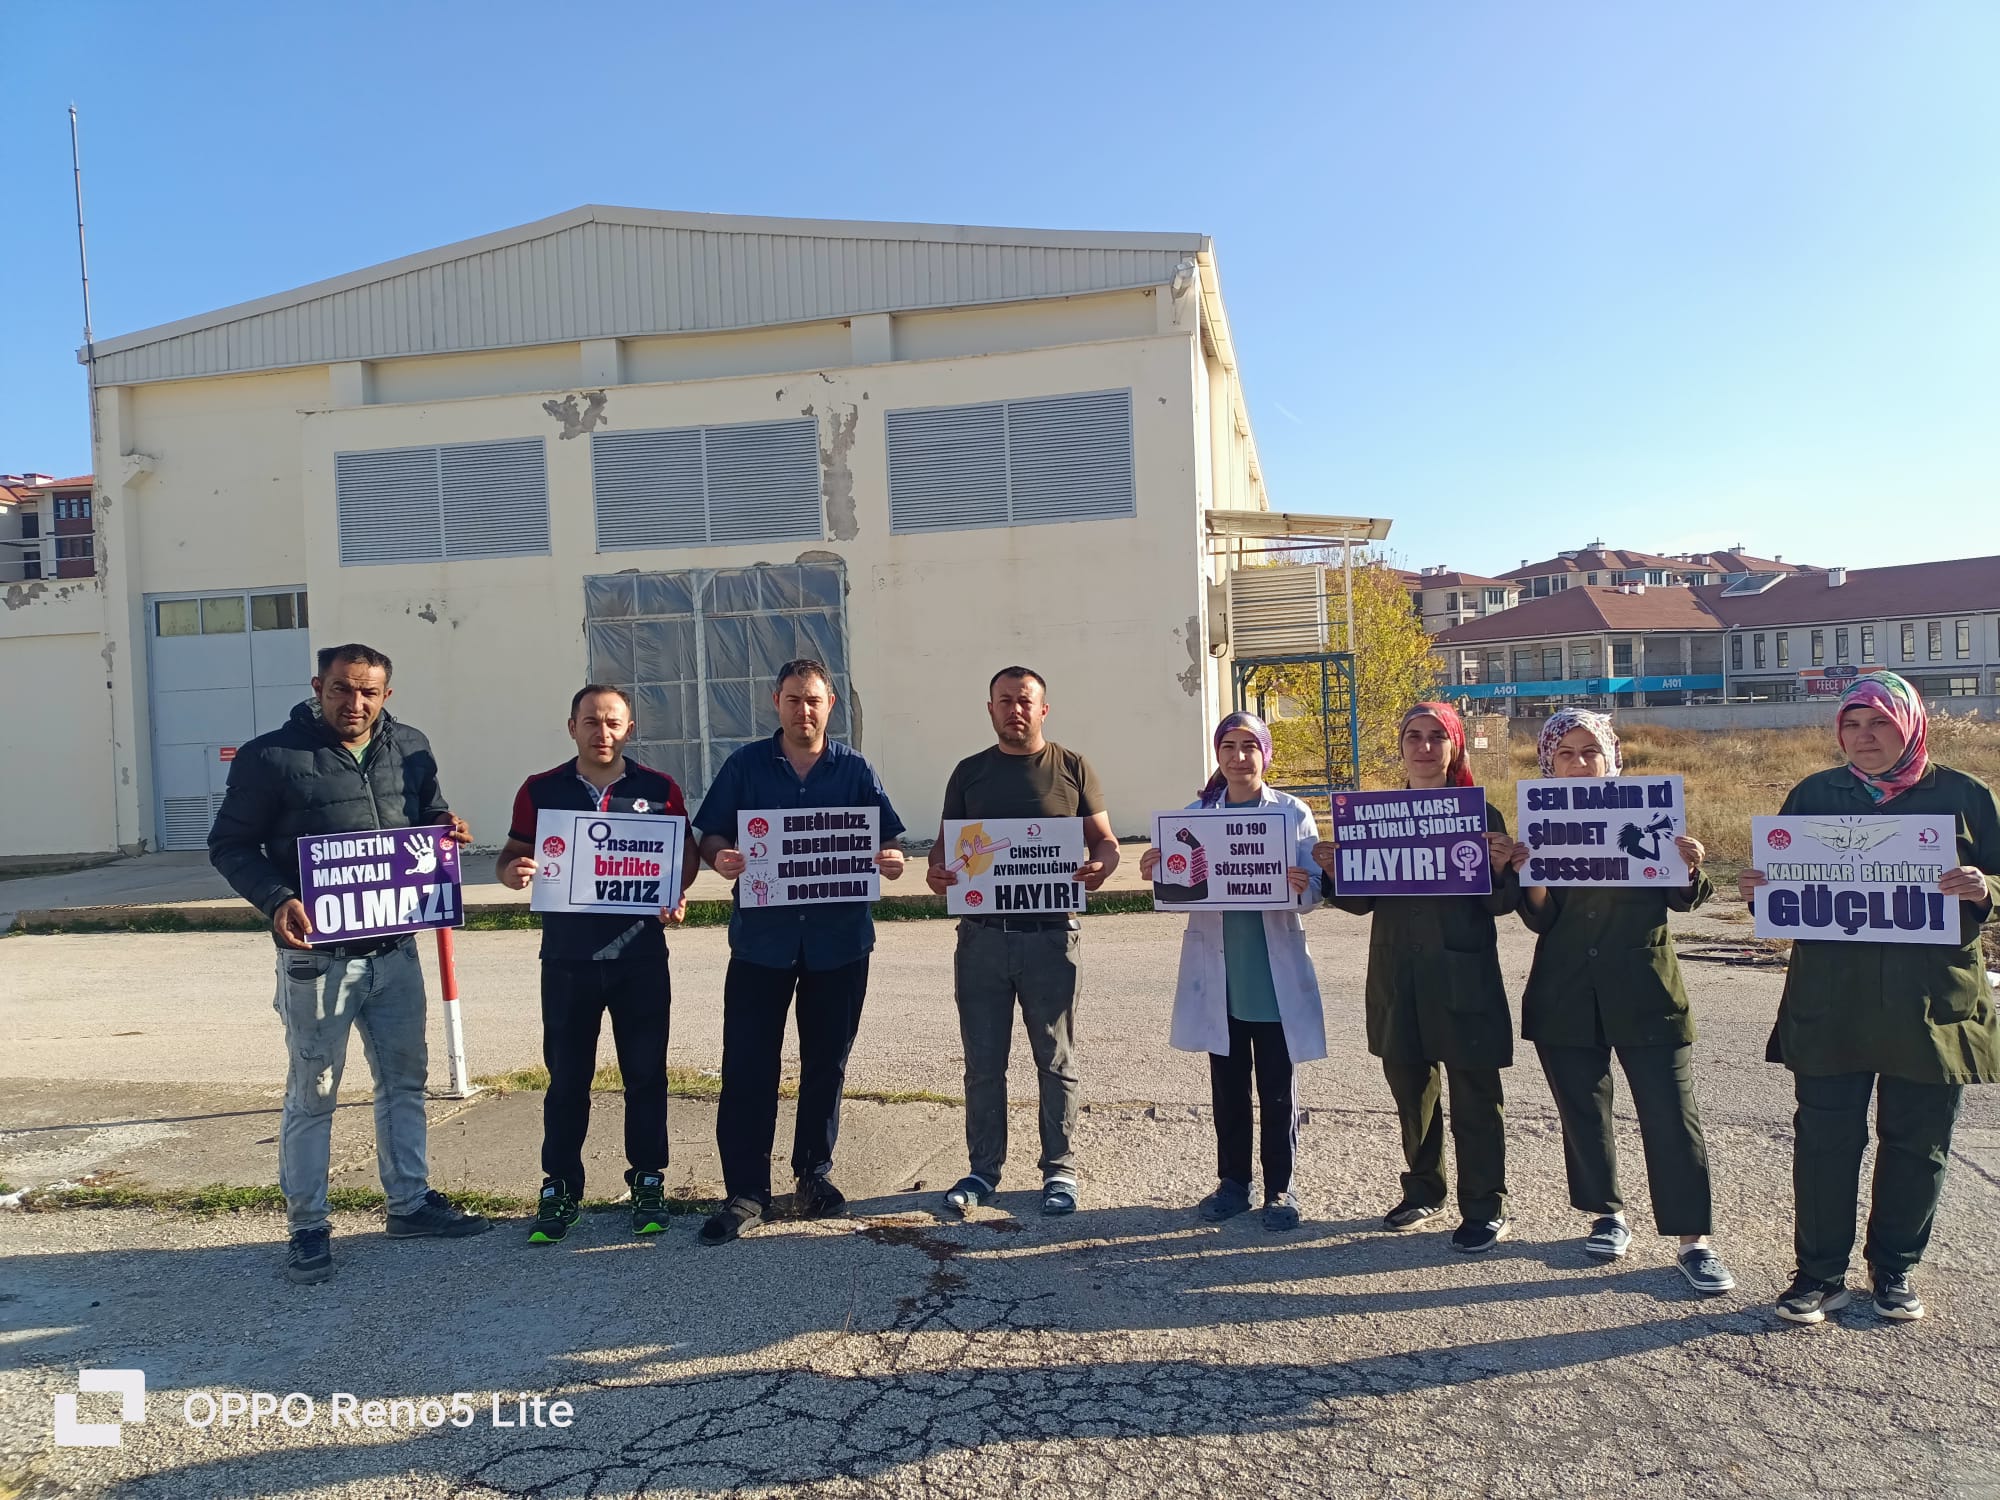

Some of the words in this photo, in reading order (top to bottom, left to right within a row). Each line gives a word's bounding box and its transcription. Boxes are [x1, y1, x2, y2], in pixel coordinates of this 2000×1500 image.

[1493, 685, 1517, 696] A-101
[1527, 787, 1568, 811] SEN
[1572, 781, 1644, 810] BAĞIR
[1648, 780, 1673, 808] Kİ
[1354, 801, 1411, 821] KADINA
[1412, 797, 1460, 817] KARŞI
[1226, 823, 1243, 836] ILO
[1245, 822, 1267, 835] 190
[1338, 824, 1367, 841] HER
[1369, 818, 1416, 839] TÜRLÜ
[1418, 815, 1482, 839] ŞİDDETE
[1528, 818, 1608, 850] ŞİDDET
[310, 834, 396, 864] ŞİDDETİN
[782, 834, 872, 856] BEDENİMİZE
[1009, 844, 1061, 859] CİNSİYET
[1230, 842, 1264, 856] SAYILI
[312, 862, 391, 888] MAKYAJI
[594, 855, 660, 876] birlikte
[993, 861, 1078, 876] AYRIMCILIĞINA
[1214, 860, 1282, 878] SÖZLEŞMEYİ
[1341, 847, 1447, 882] HAYIR!
[1767, 862, 1854, 882] KADINLAR
[1860, 860, 1943, 883] BİRLİKTE
[595, 880, 660, 903] varız
[995, 882, 1080, 910] HAYIR!
[1227, 881, 1272, 896] İMZALA!
[314, 882, 455, 934] OLMAZ!
[1768, 884, 1945, 935] GÜÇLÜ!
